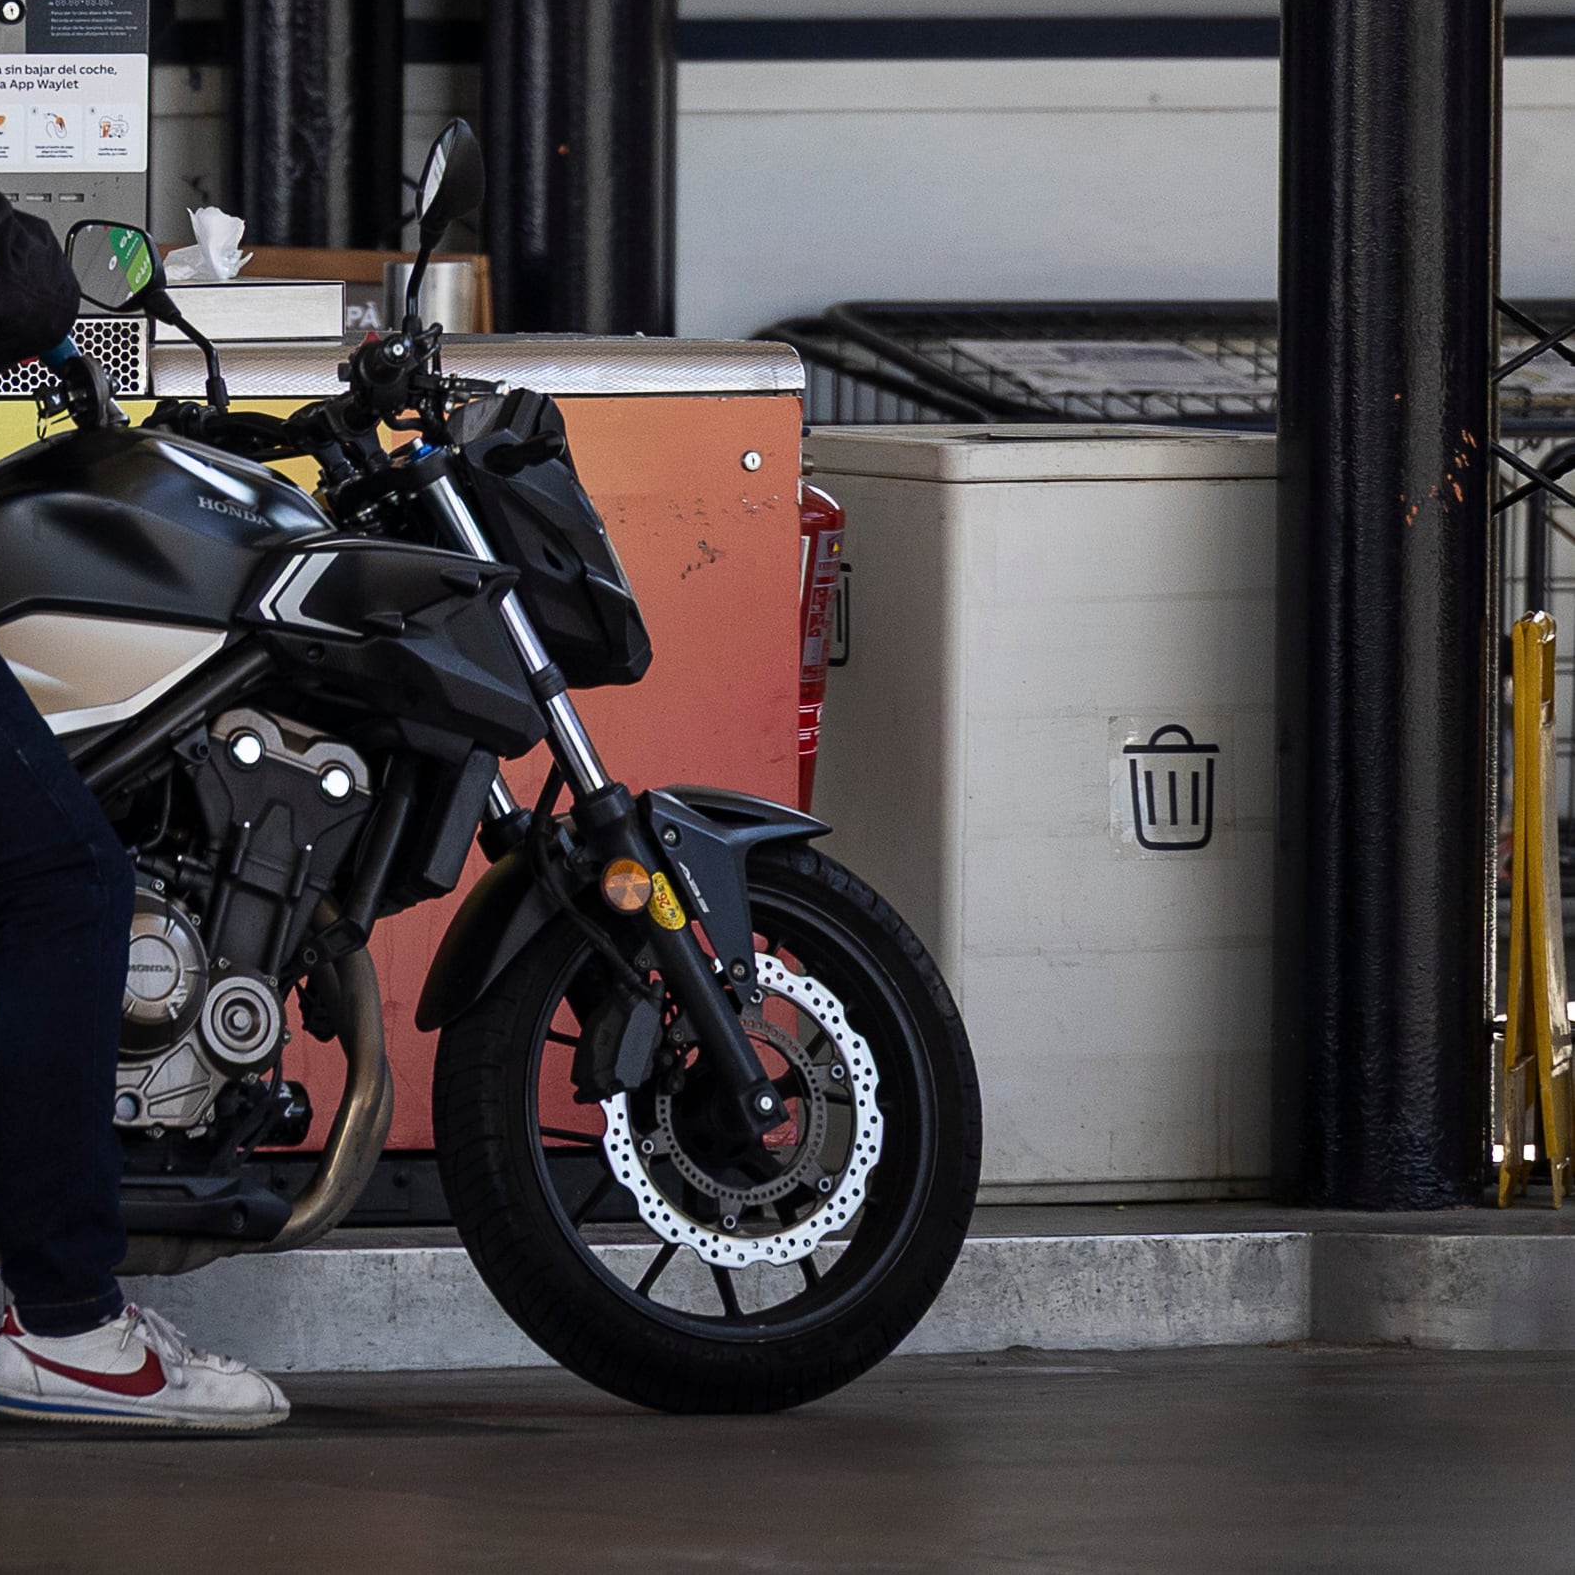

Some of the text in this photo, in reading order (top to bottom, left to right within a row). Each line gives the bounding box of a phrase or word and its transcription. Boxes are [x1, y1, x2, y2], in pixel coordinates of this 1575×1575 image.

[5, 64, 23, 75] sin
[24, 64, 55, 77] bajar
[57, 64, 77, 75] del
[79, 65, 117, 76] coche,
[9, 79, 34, 91] App
[37, 79, 79, 92] Waylet
[197, 495, 273, 528] HONDA
